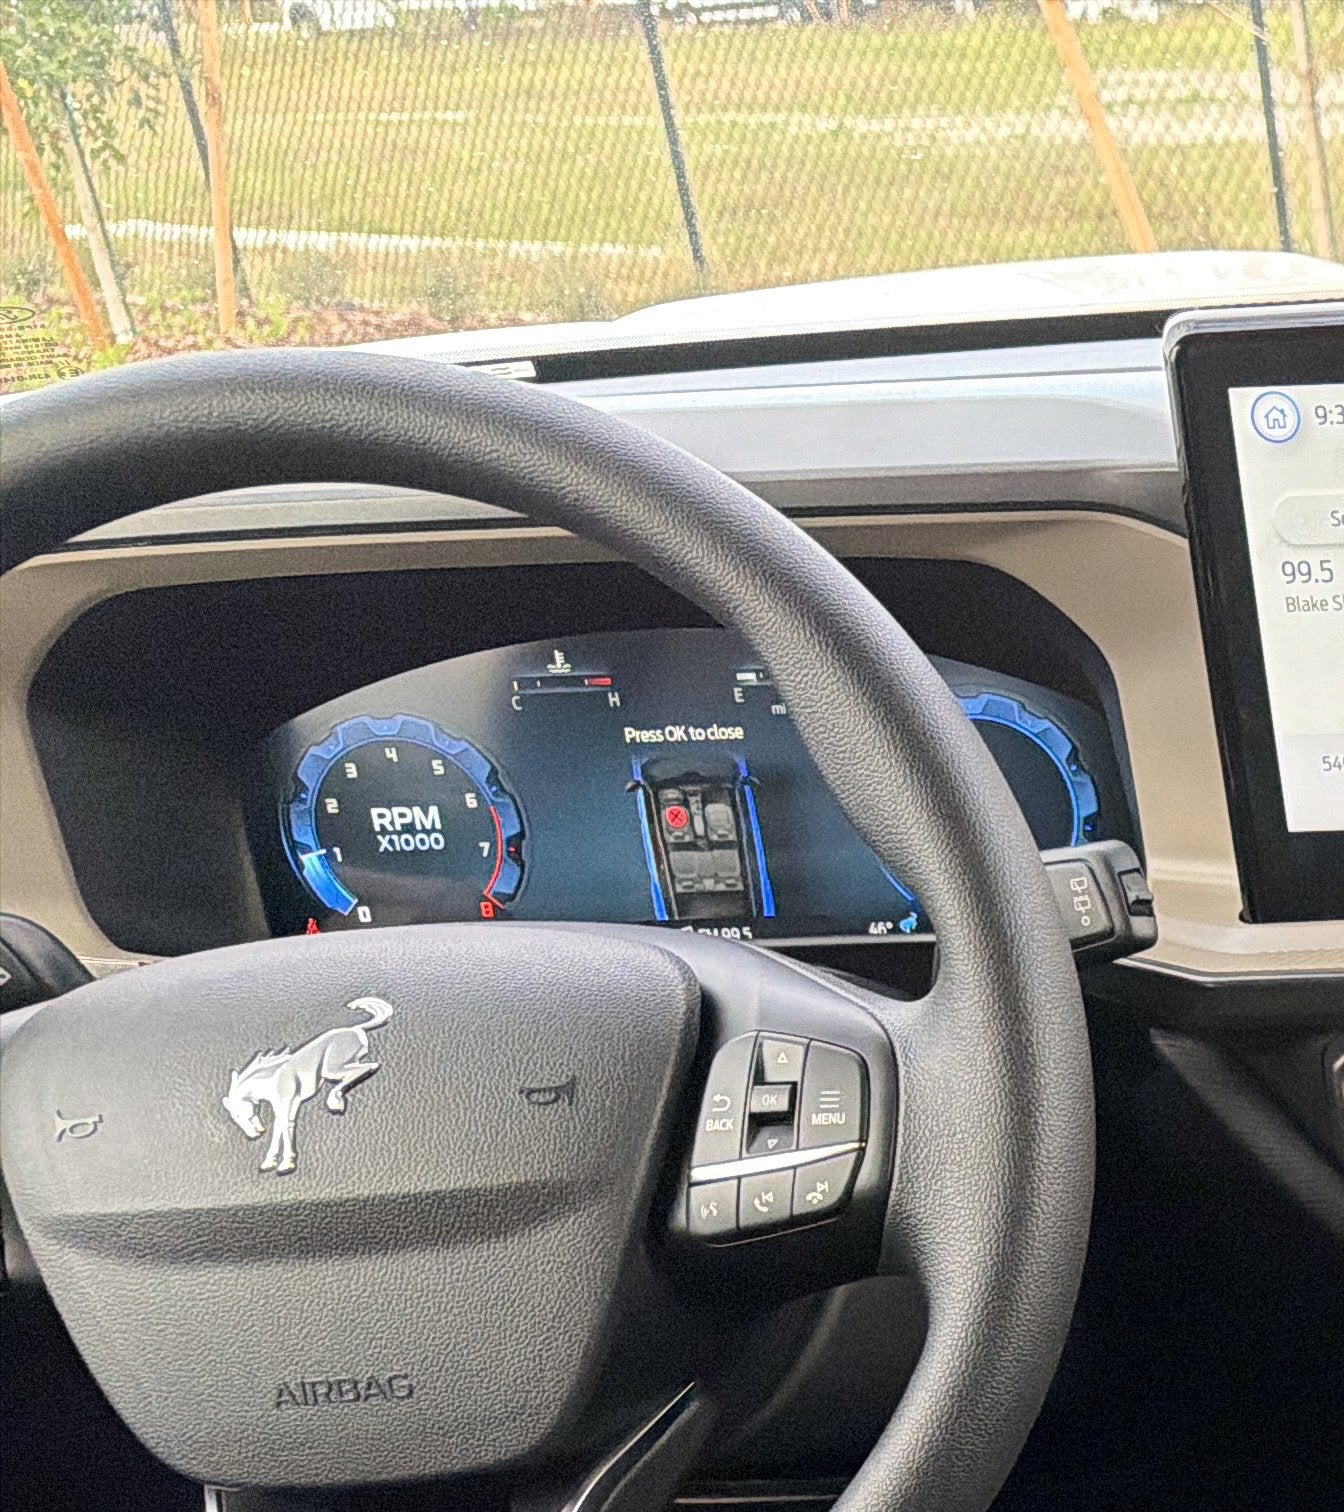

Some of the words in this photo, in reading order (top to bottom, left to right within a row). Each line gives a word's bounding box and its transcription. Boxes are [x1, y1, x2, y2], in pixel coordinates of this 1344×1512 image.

[1281, 560, 1335, 584] 99.5
[1285, 593, 1330, 614] Blake
[608, 691, 621, 707] H
[733, 687, 745, 703] E
[624, 726, 664, 743] Press
[665, 725, 687, 742] OK
[689, 726, 705, 741] to
[707, 724, 744, 741] close
[385, 747, 399, 763] 4
[344, 762, 358, 778] 3
[431, 759, 445, 775] 5
[325, 798, 339, 814] 2
[465, 792, 478, 809] 6
[370, 805, 442, 832] RPM
[376, 832, 445, 852] X1000
[479, 841, 490, 858] 7
[332, 846, 343, 862] 1
[357, 906, 372, 923] 0
[480, 901, 495, 918] 8
[761, 1094, 778, 1106] OK
[705, 1118, 734, 1132] BACK
[811, 1112, 846, 1126] MENU
[274, 1373, 415, 1411] AIRBAG
